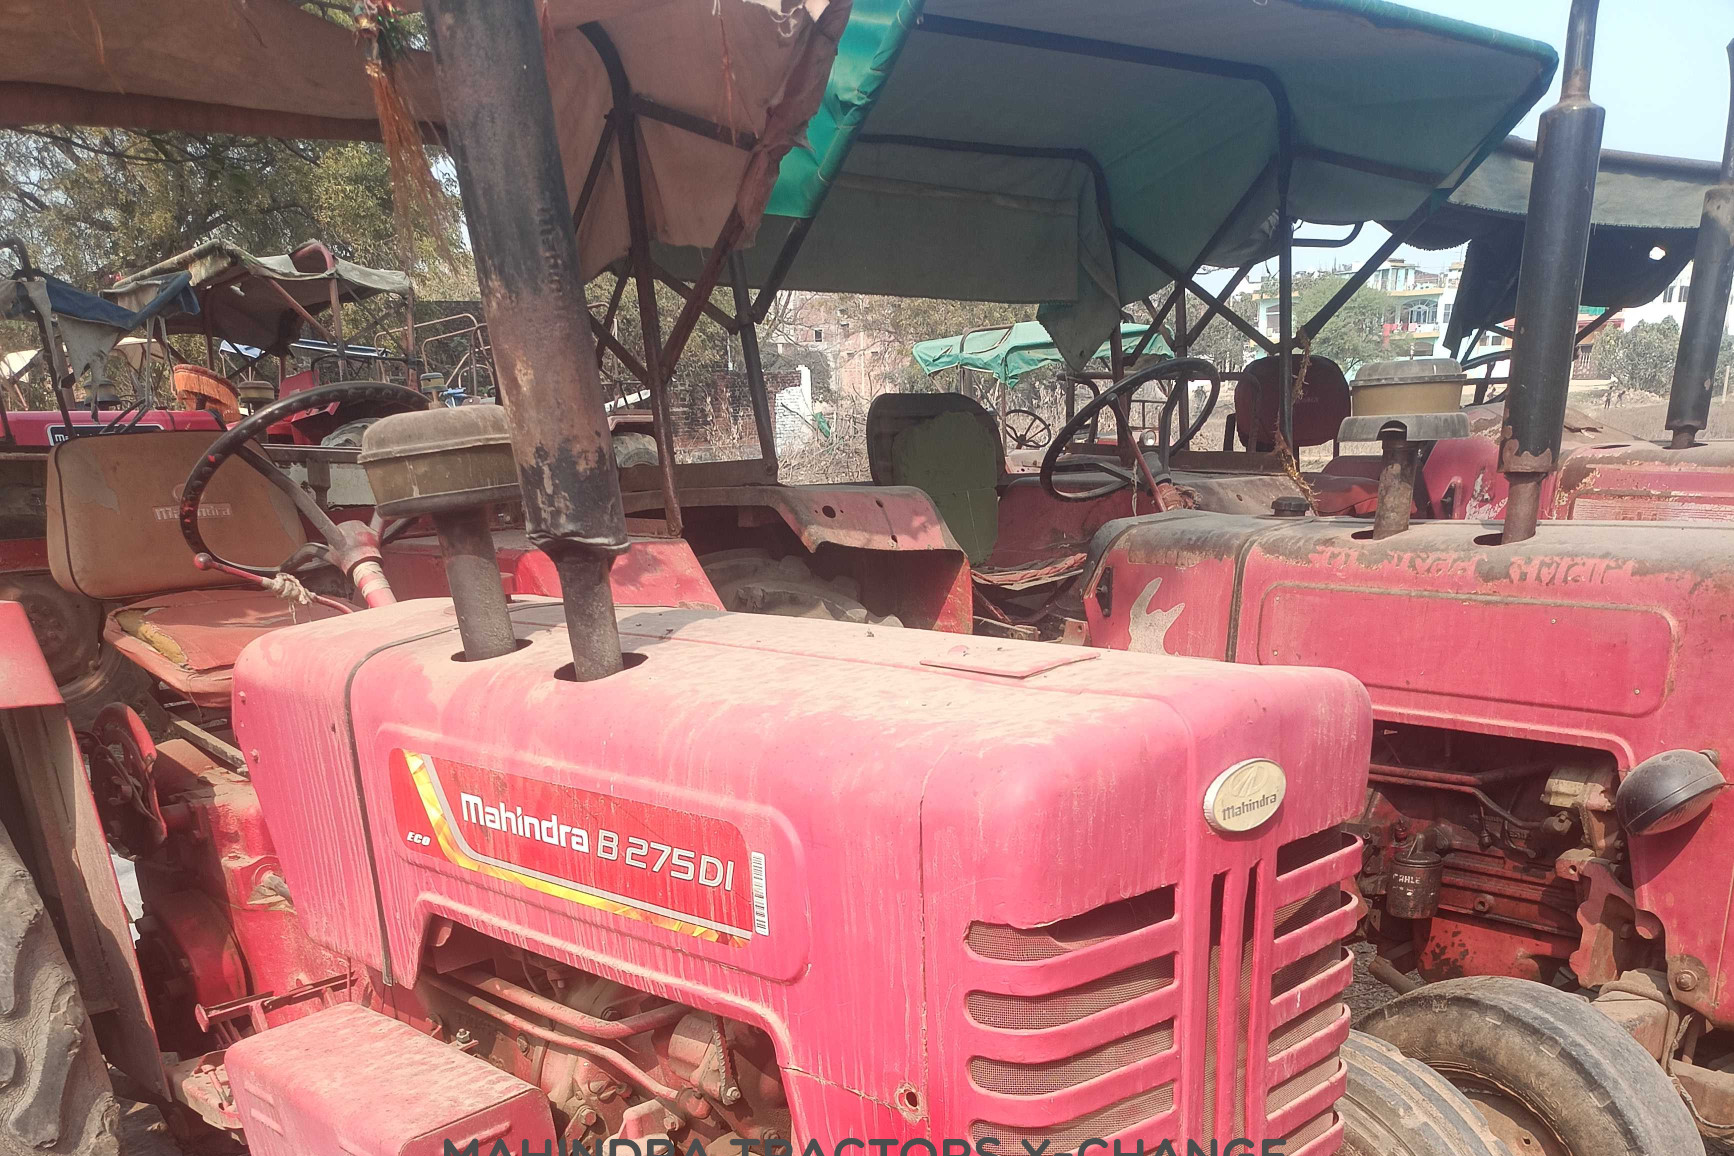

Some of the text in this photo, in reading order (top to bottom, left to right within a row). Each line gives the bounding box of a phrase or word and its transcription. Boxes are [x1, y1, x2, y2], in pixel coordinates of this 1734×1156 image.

[154, 505, 231, 521] Mandra
[1222, 793, 1277, 821] Mahindra
[460, 792, 590, 854] Mahindra
[597, 828, 619, 861] B
[406, 832, 431, 846] ECO
